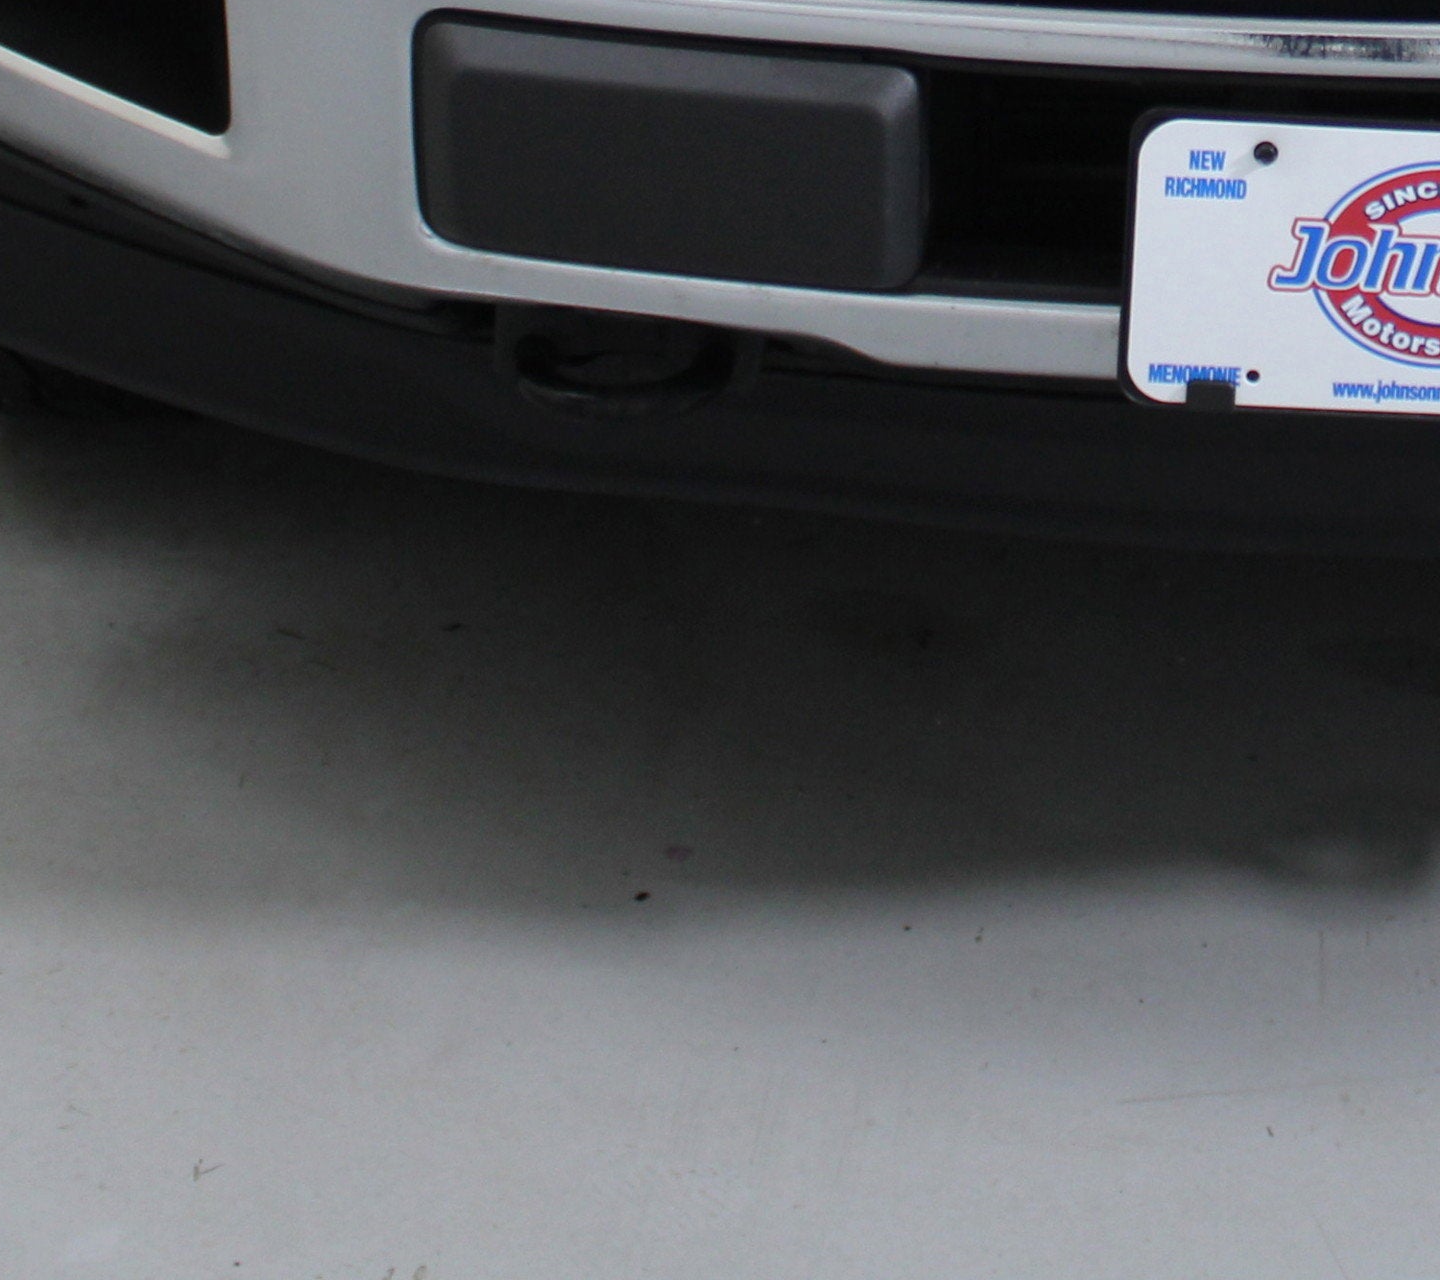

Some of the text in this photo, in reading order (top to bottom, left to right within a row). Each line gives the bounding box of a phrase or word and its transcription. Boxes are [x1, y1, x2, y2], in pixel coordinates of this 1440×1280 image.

[1189, 150, 1226, 171] NEW
[1164, 176, 1247, 200] RICHMOND
[1148, 363, 1241, 386] MENOMONIE
